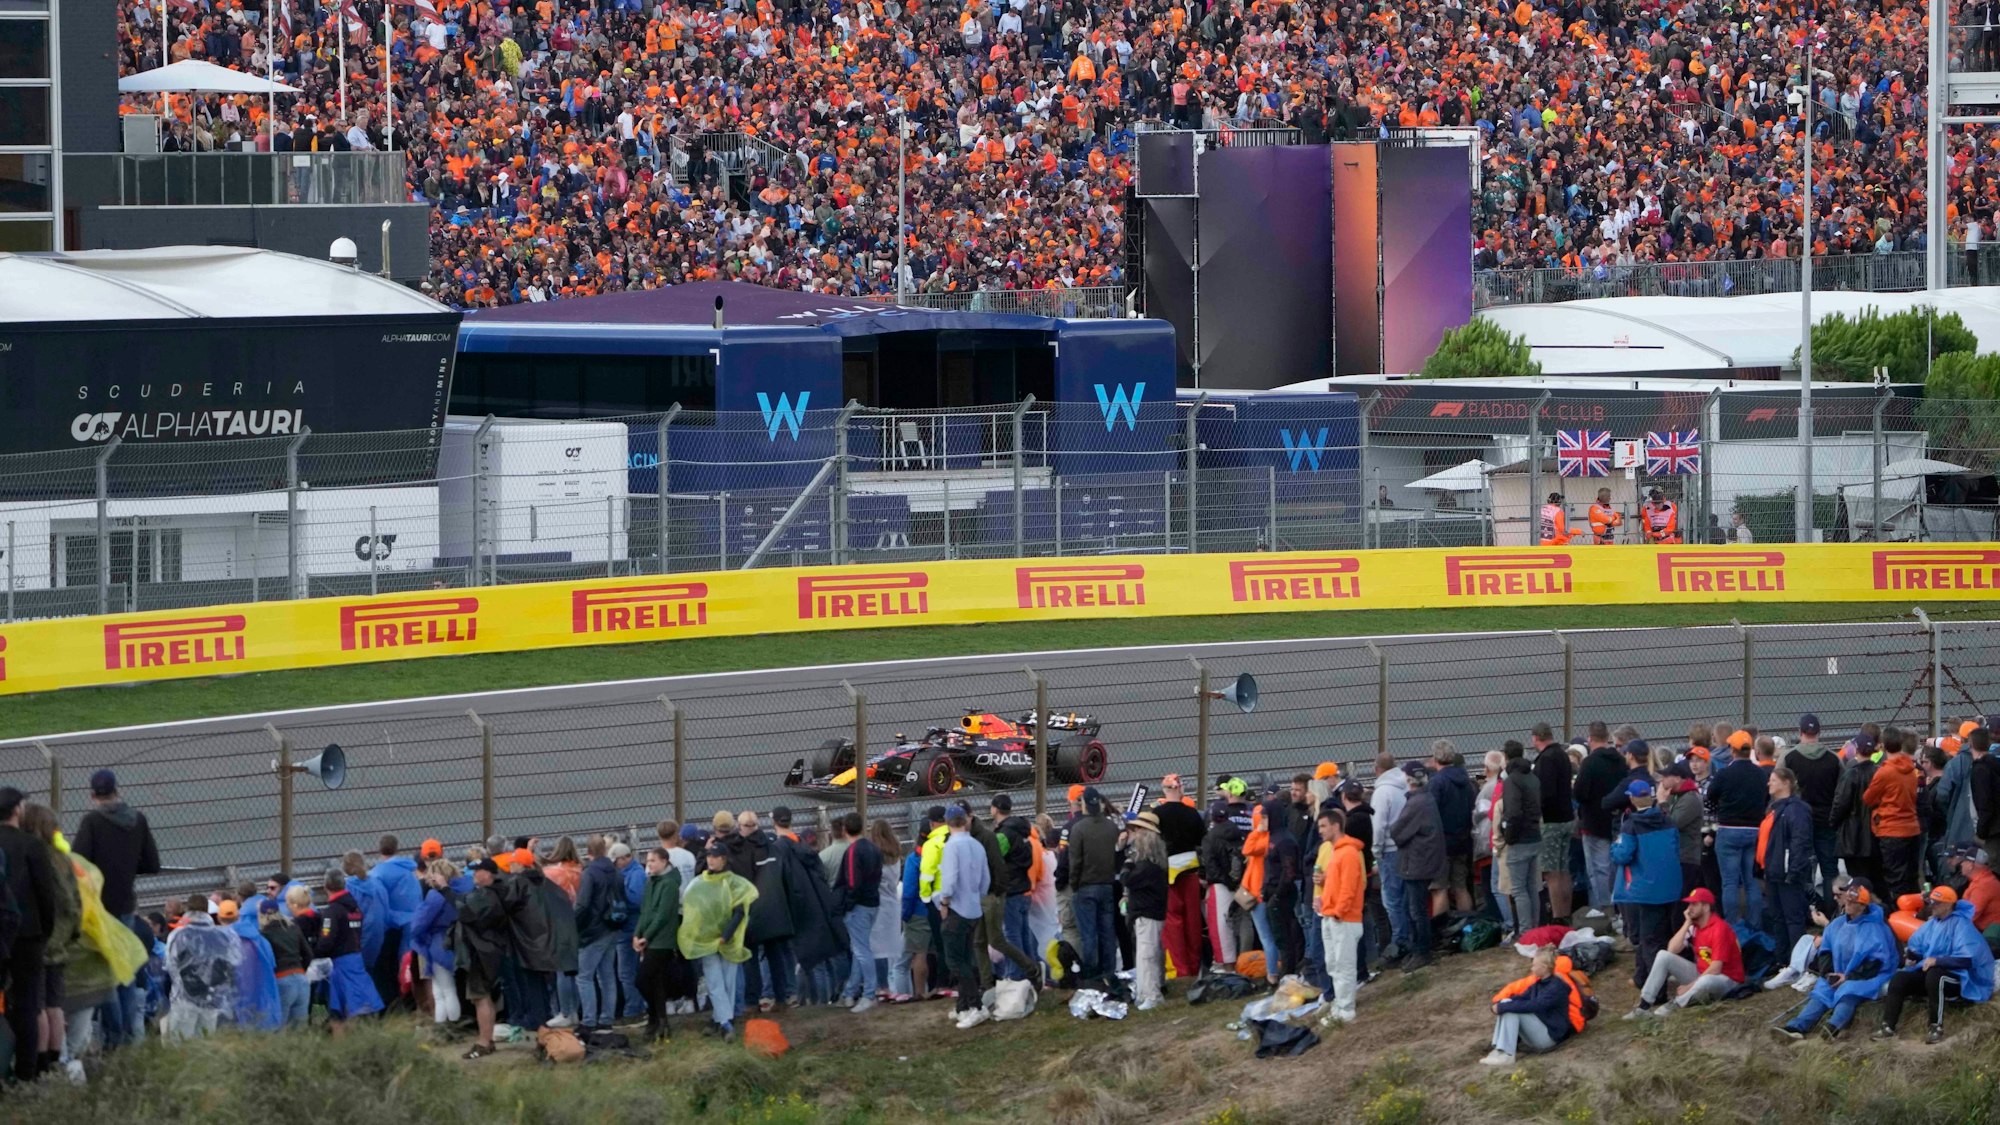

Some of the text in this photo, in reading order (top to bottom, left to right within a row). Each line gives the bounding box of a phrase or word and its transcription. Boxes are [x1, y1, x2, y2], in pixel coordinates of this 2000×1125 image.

[381, 333, 451, 343] ALPHATAURI.COM
[77, 380, 304, 400] SCUDERIA
[1094, 382, 1146, 432] W
[1468, 401, 1549, 419] PADDOK
[1558, 404, 1605, 421] CLUB
[122, 408, 303, 438] ALPHATAURI
[756, 391, 811, 441] W
[1280, 427, 1329, 475] W
[1017, 566, 1145, 608] PIRELLI
[1231, 558, 1360, 600] PIRELLI
[1446, 553, 1572, 596] PIRELLI
[1658, 552, 1785, 592] PIRELLI
[1873, 551, 2000, 590] PIRELLI
[573, 582, 708, 634] PIRELLI
[798, 572, 929, 619] PIRELLI
[104, 615, 245, 669] PIRELLI
[341, 597, 479, 651] PIRELLI
[975, 752, 1033, 766] ORACLE
